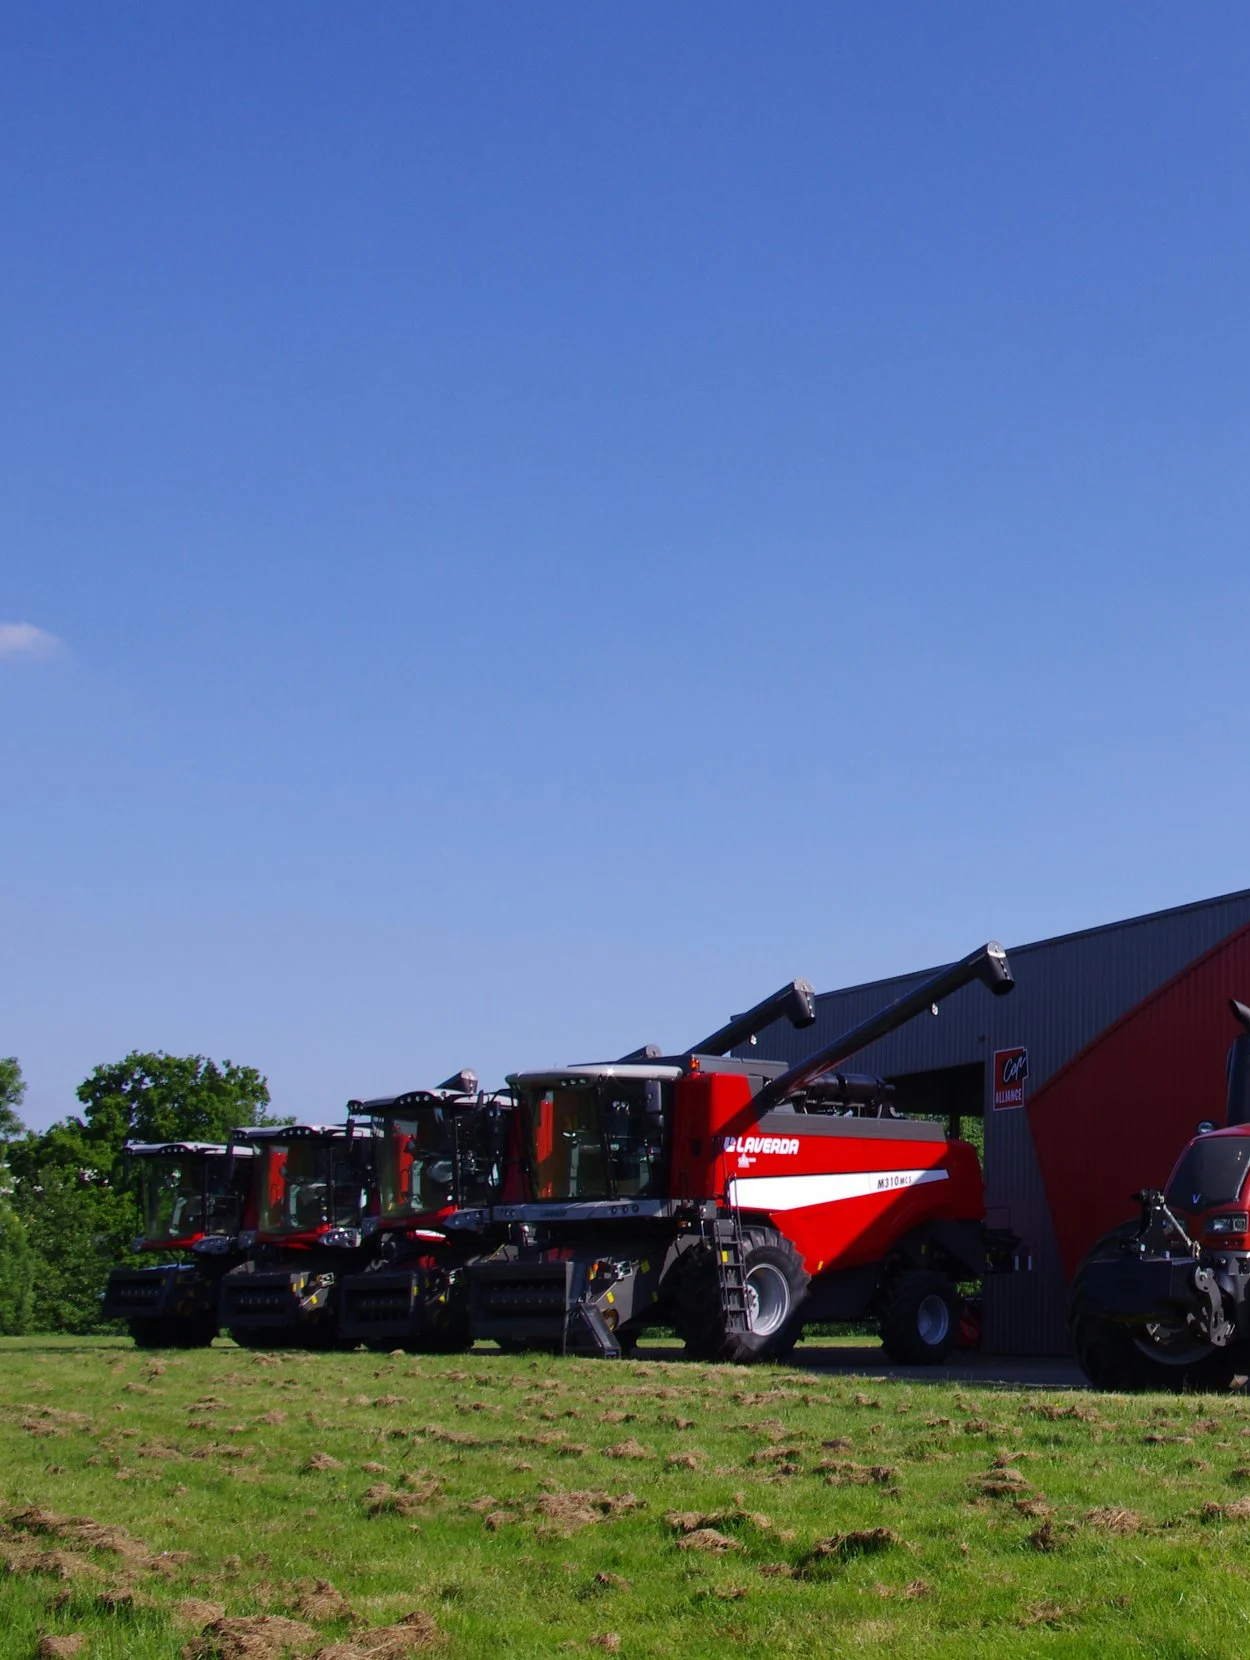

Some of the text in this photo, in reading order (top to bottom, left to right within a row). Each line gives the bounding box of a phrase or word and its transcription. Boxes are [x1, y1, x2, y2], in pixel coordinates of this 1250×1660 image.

[995, 1088, 1022, 1104] ALLIANCE
[736, 1136, 799, 1155] LAVERDA
[877, 1176, 899, 1189] M310
